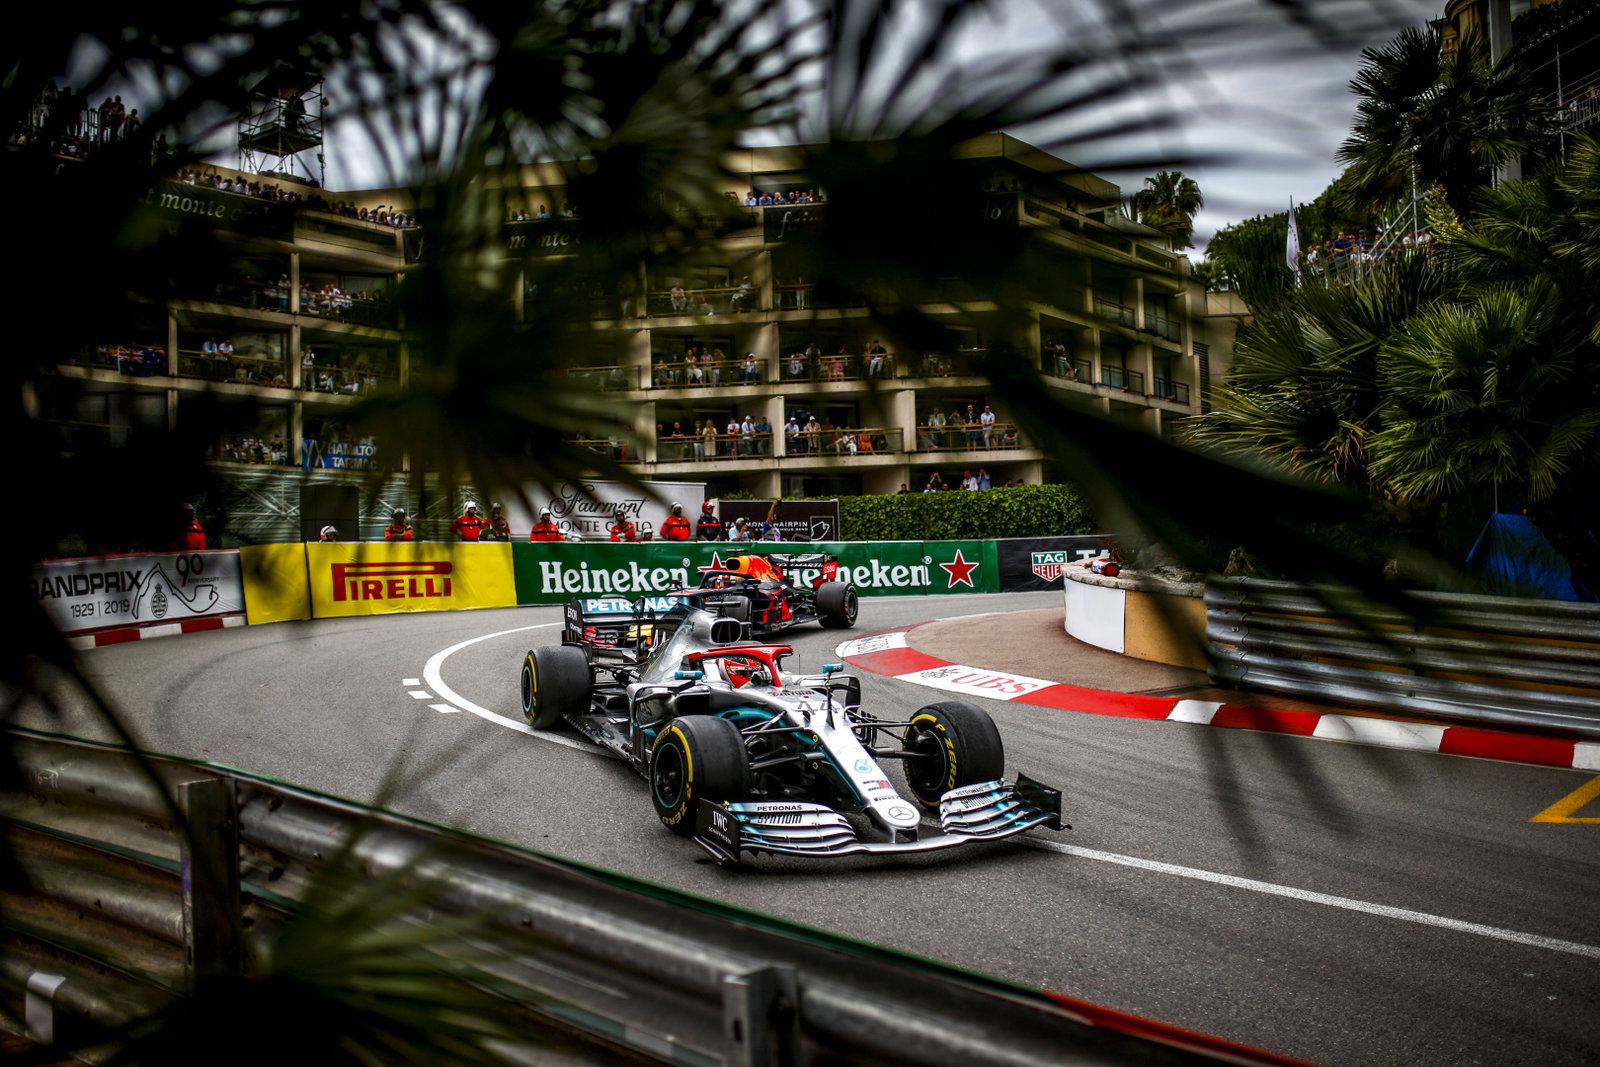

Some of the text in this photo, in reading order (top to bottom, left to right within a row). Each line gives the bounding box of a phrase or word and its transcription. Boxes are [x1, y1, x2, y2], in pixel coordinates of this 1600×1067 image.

[160, 193, 225, 219] monte
[509, 233, 569, 250] mnte
[604, 520, 652, 533] CLO
[1034, 553, 1065, 564] TAG
[176, 554, 203, 587] 90
[331, 561, 453, 602] PIRELLI
[71, 599, 130, 618] 1929 2019
[586, 597, 679, 612] PETRNAS
[951, 672, 1040, 694] UBS
[757, 804, 803, 812] PETRONAS
[713, 810, 728, 832] IWC
